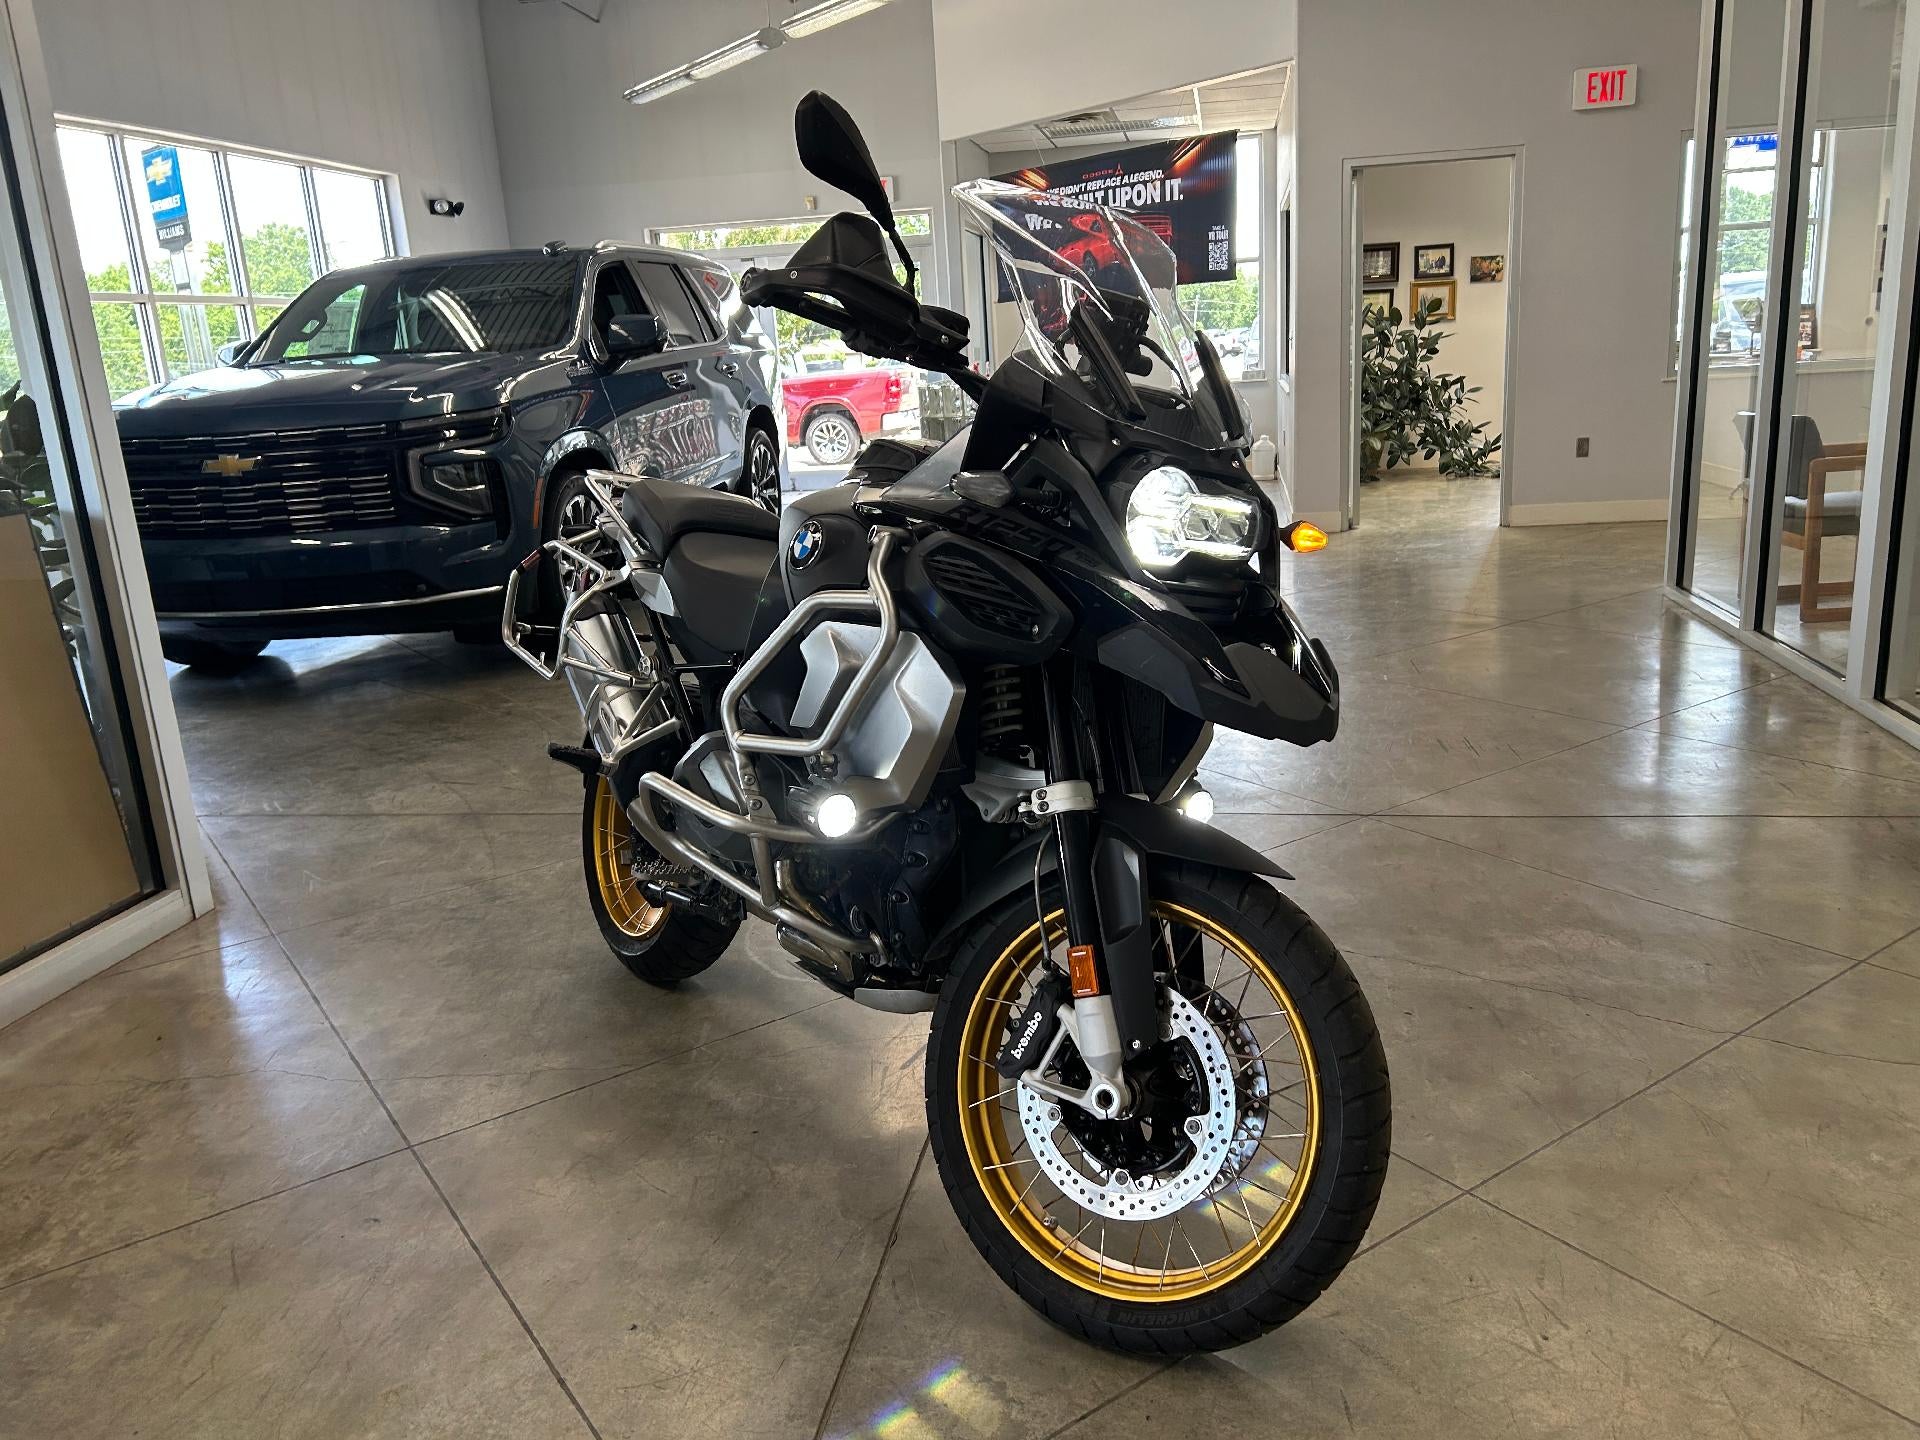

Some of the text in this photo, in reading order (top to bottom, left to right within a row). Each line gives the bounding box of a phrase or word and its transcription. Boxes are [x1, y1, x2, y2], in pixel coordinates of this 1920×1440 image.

[1587, 69, 1627, 104] EXIT
[1060, 183, 1086, 195] DIDN'T
[1087, 176, 1121, 191] REPLACE
[1122, 174, 1130, 184] A
[1130, 169, 1165, 182] LEGEND.
[1082, 169, 1114, 180] DODGE
[1108, 181, 1161, 207] UPON
[1165, 178, 1184, 202] IT.
[158, 224, 185, 240] WILLIAMS
[1011, 1011, 1043, 1060] brembo
[1119, 1309, 1199, 1327] MICHELIN
